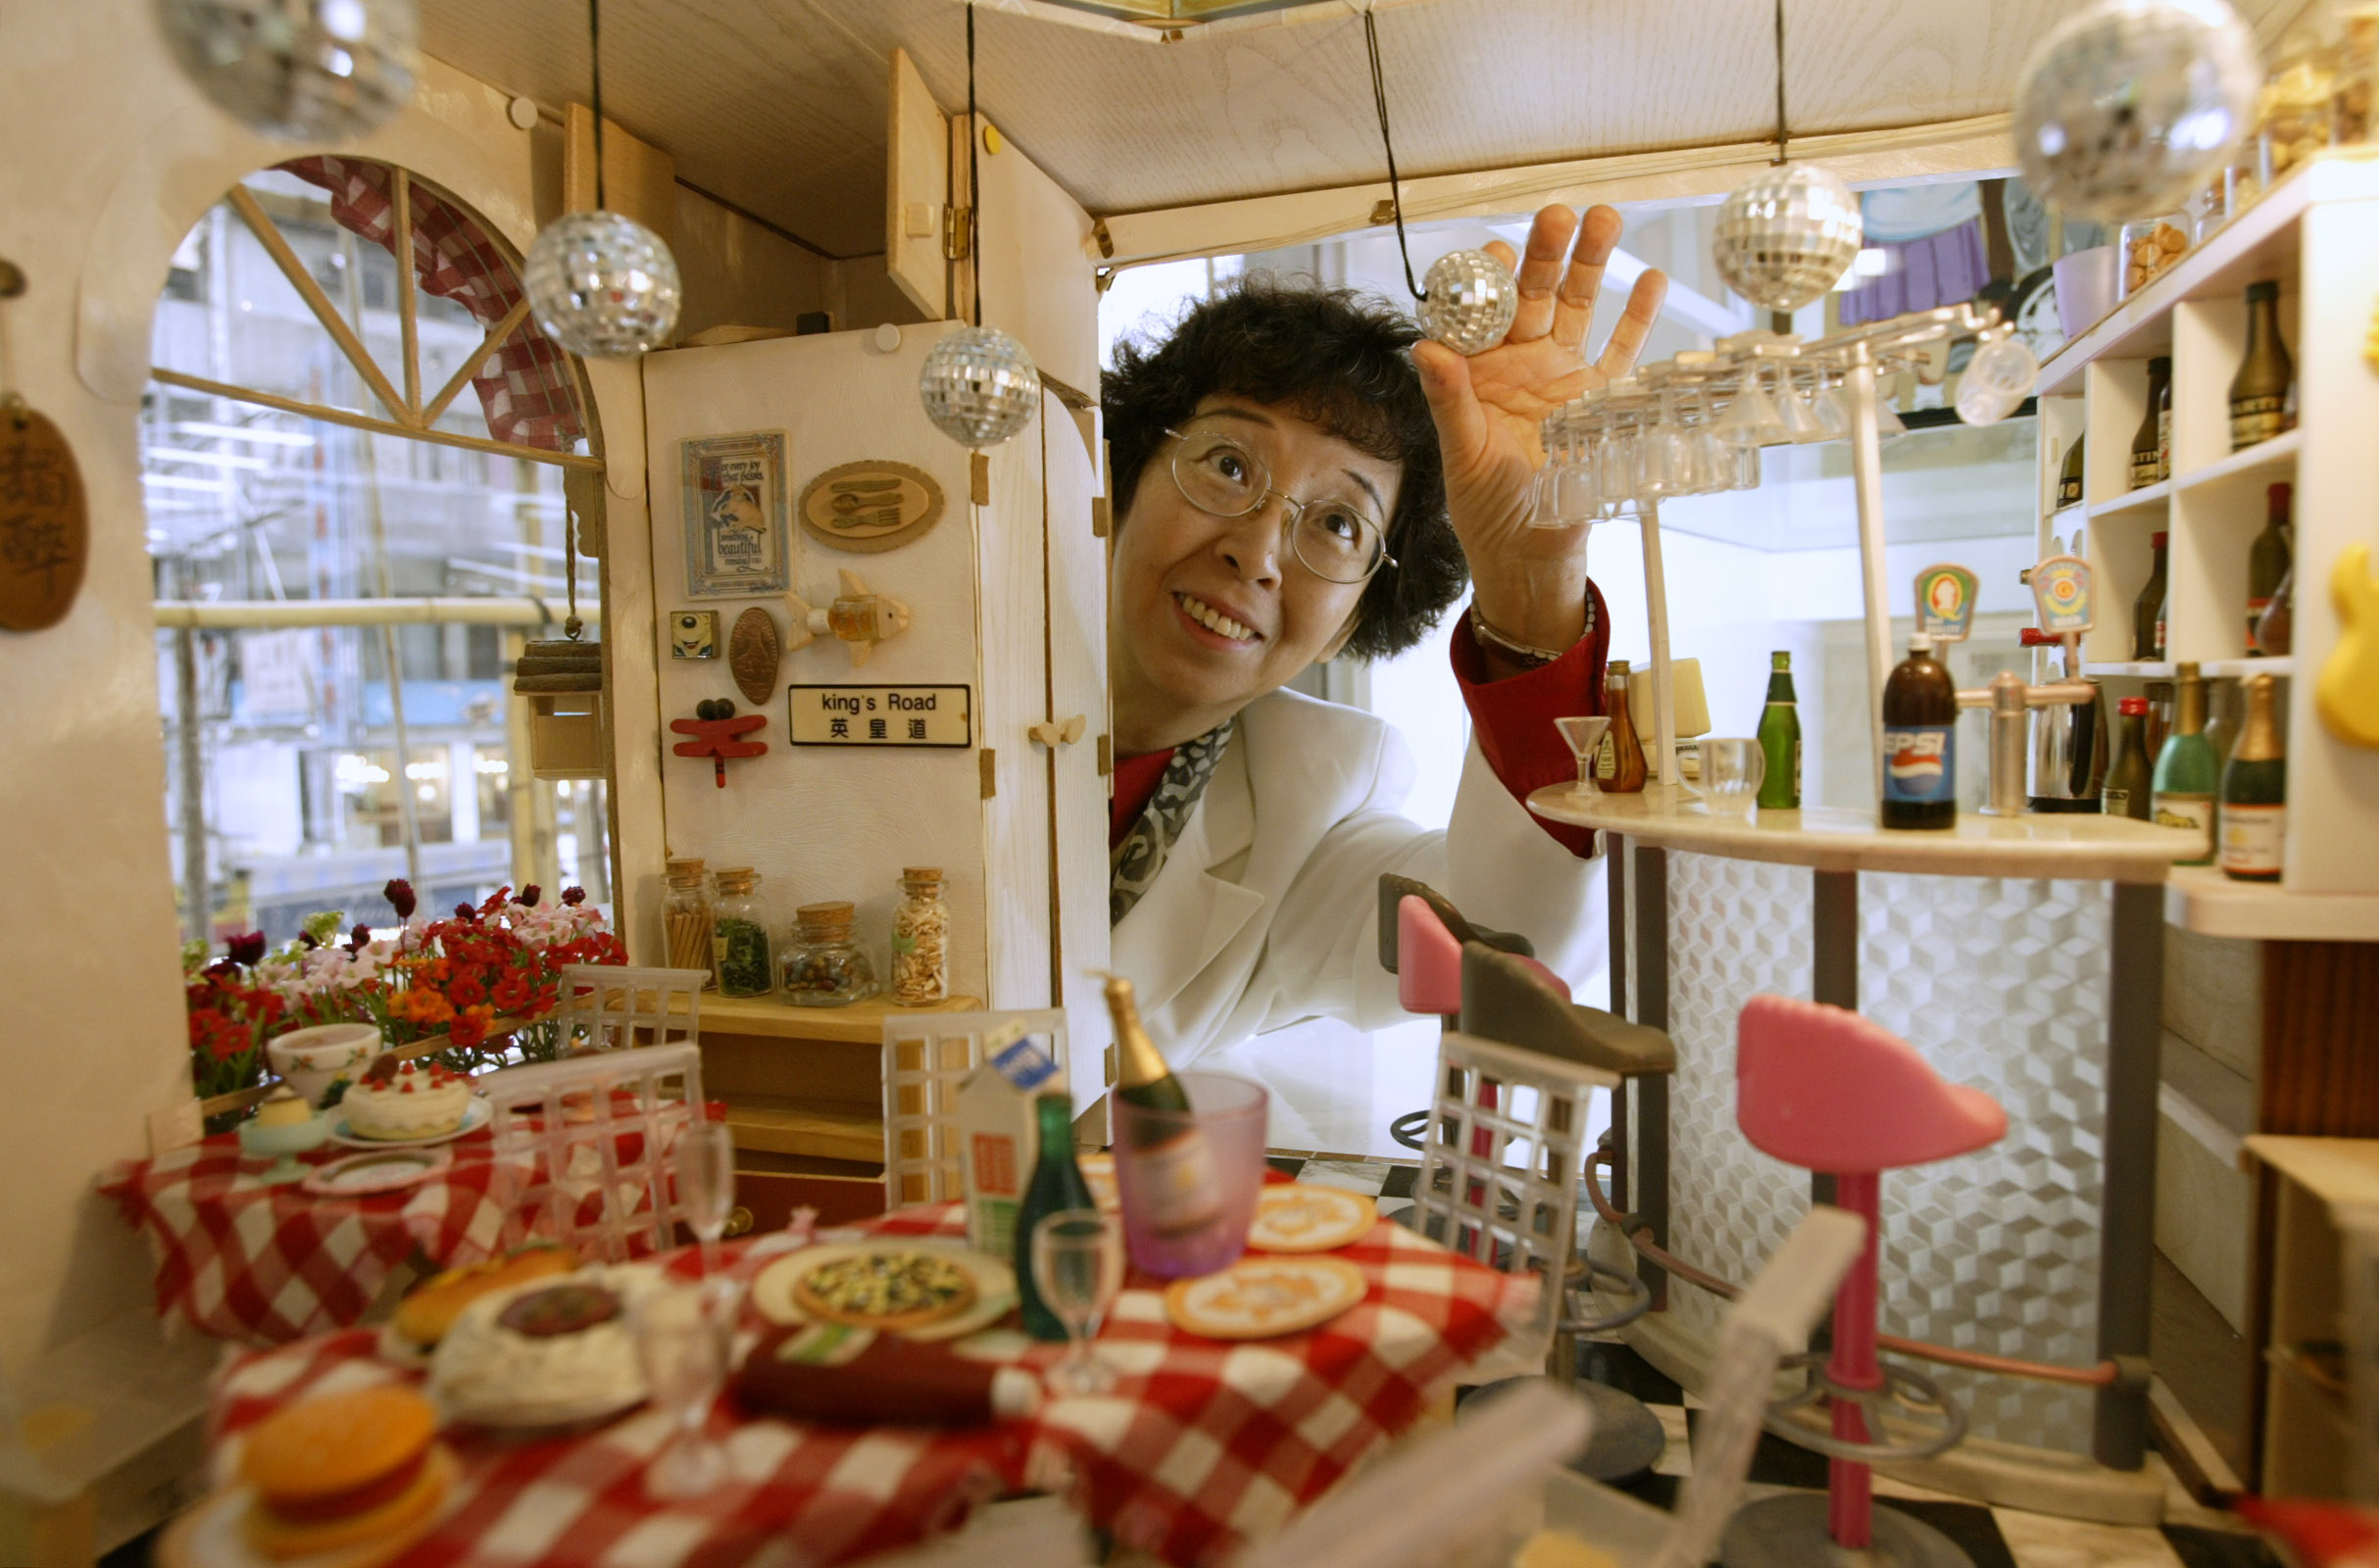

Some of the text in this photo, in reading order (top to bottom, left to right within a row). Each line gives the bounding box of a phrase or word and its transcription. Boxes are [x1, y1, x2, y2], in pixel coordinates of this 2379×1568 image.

[822, 693, 936, 714] king's Road
[830, 718, 926, 739] 英皇道
